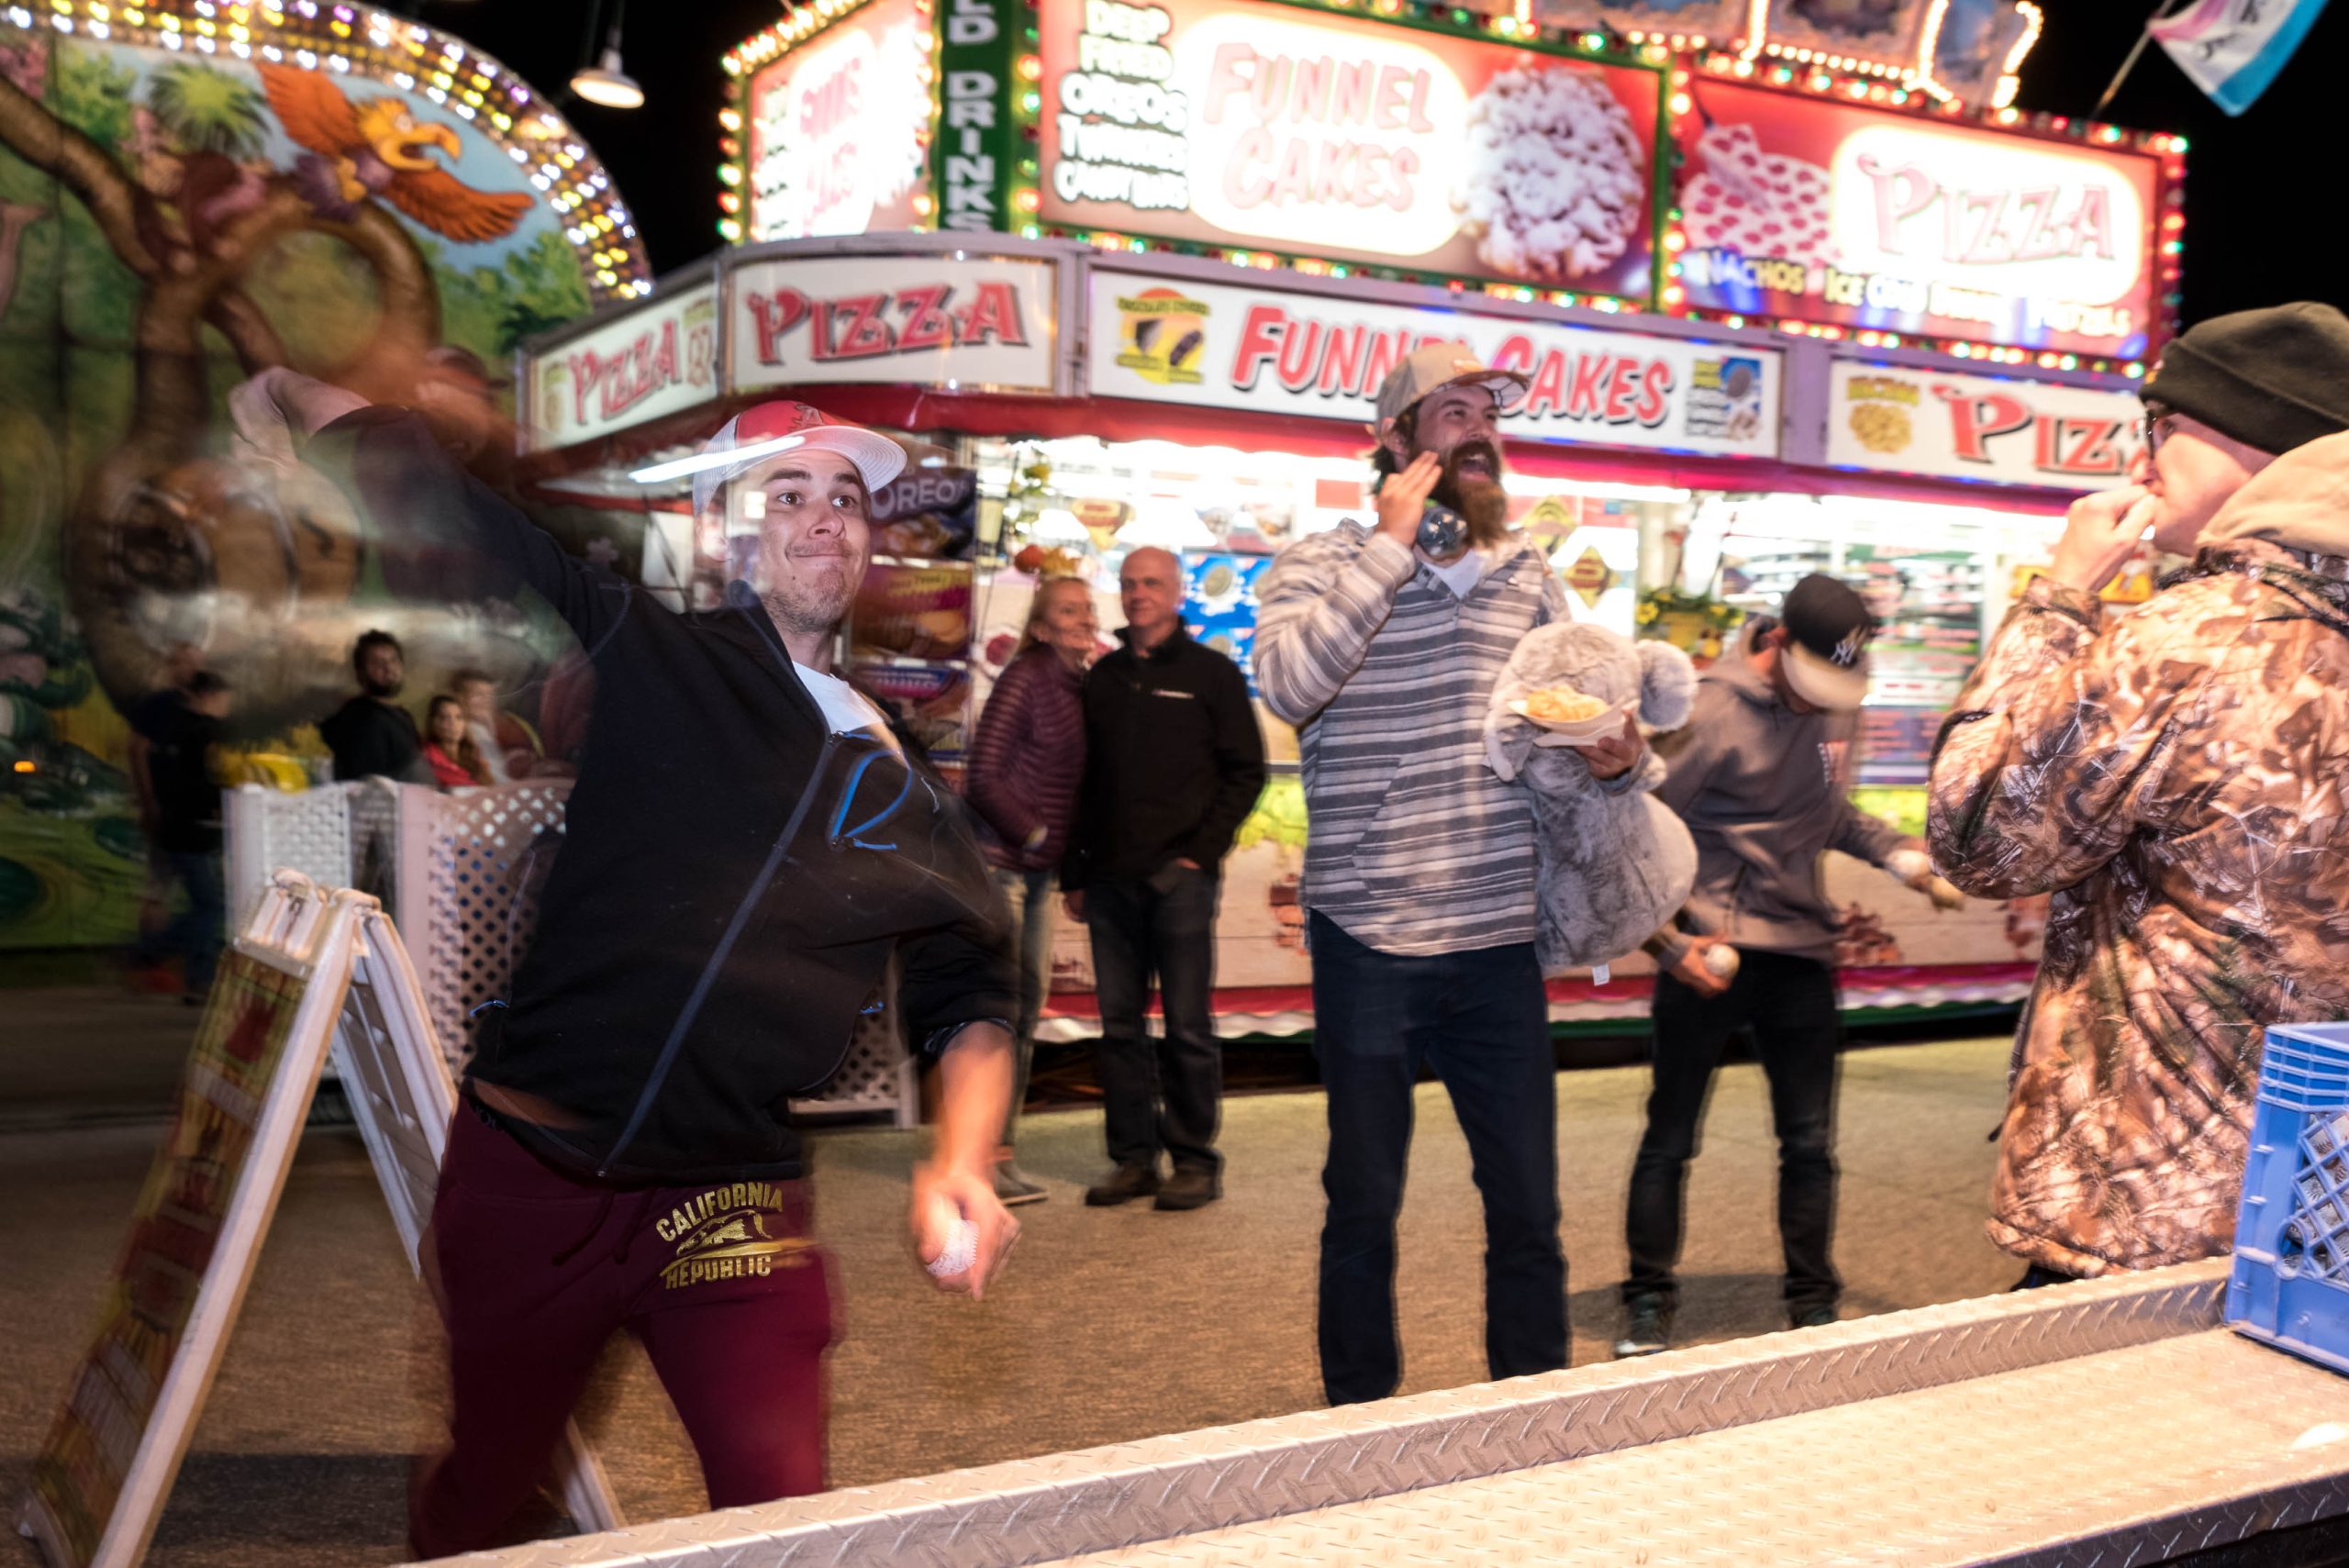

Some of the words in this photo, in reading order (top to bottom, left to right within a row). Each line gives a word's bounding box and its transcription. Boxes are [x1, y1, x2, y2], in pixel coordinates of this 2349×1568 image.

[1061, 72, 1189, 133] OREOS
[1203, 42, 1434, 133] FUNNEL
[944, 71, 997, 230] DRINKS
[1223, 128, 1420, 212] CAKES
[1857, 152, 2116, 264] PIZZA
[747, 281, 1027, 364] PIZZA
[1231, 304, 1466, 400] FUNN
[1490, 335, 1672, 427] CAKES
[567, 318, 681, 427] PIZZA
[1929, 383, 2147, 475] PIZ
[871, 478, 957, 519] OREO
[655, 1181, 784, 1241] CALIFORNIA
[665, 1255, 772, 1290] REPUBLIC
